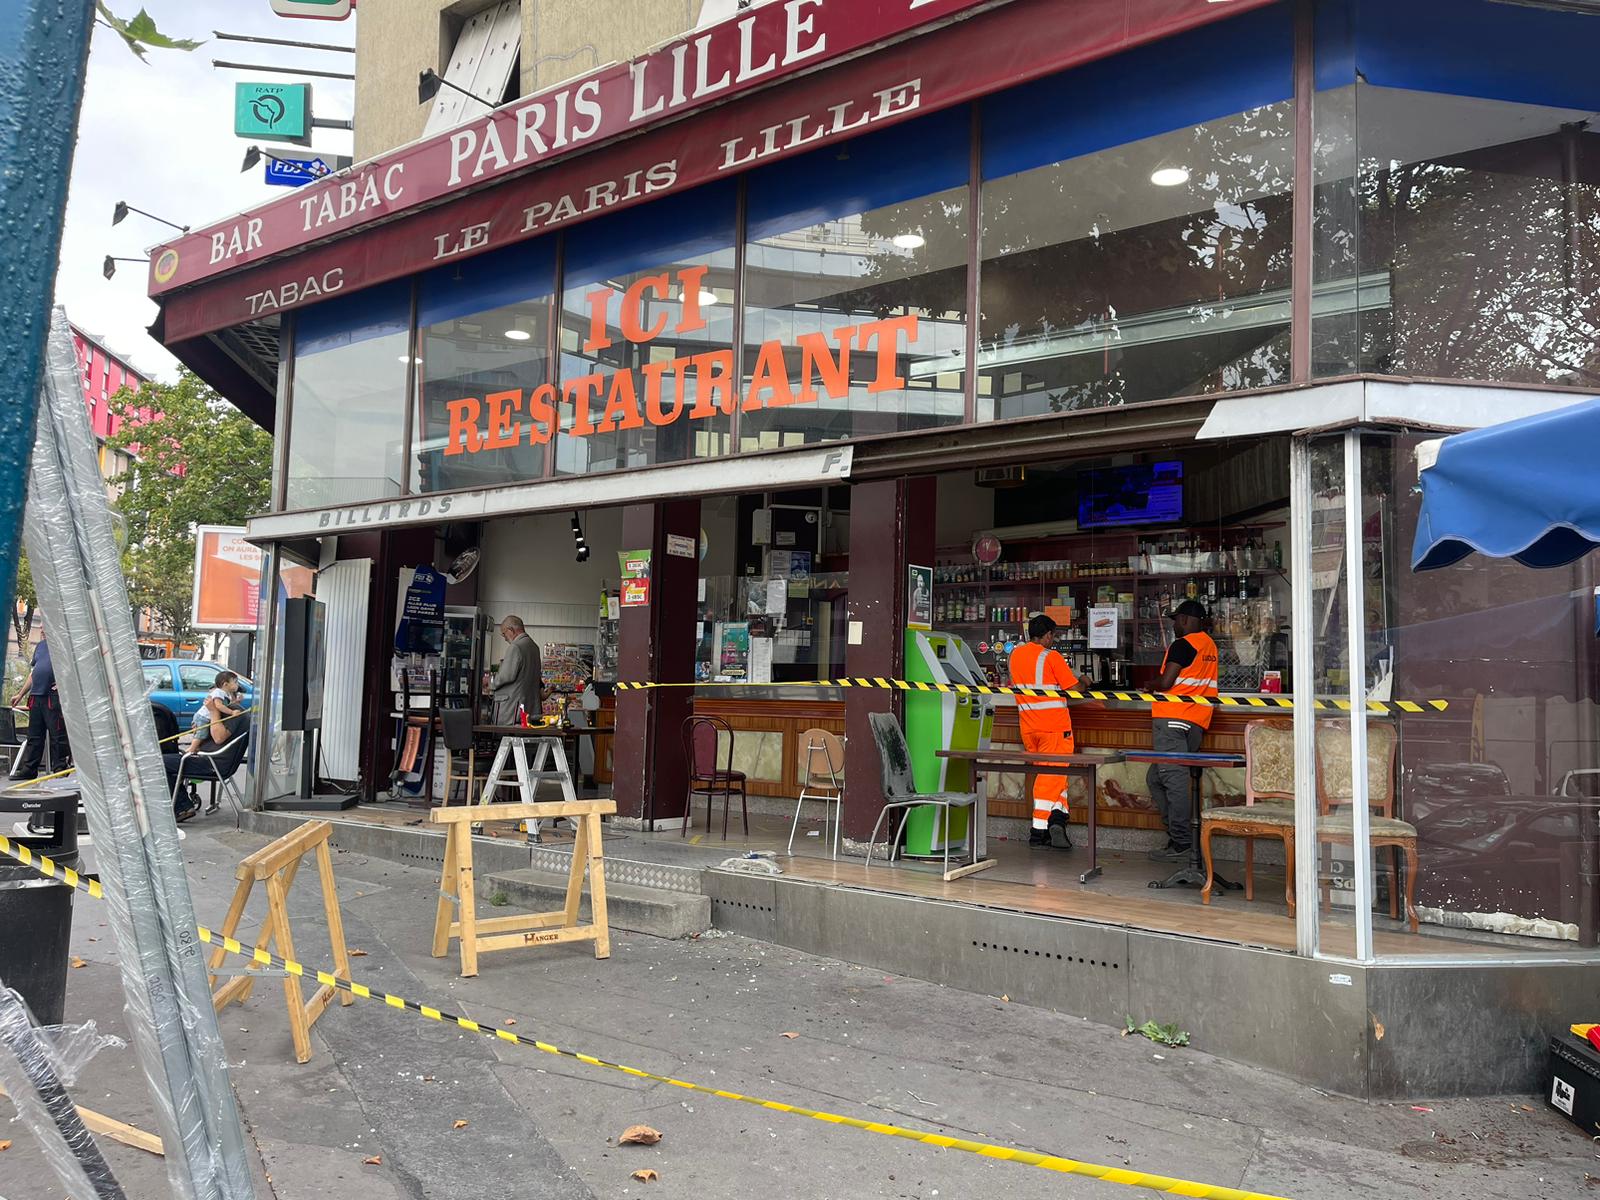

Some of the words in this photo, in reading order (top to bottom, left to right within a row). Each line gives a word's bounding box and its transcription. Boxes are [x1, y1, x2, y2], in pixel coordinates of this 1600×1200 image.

[255, 86, 284, 94] RATP
[209, 218, 263, 265] BAR
[300, 162, 404, 232] TABAC
[448, 79, 602, 187] PARIS
[628, 0, 827, 123] LILLE
[274, 160, 304, 174] FDJ
[433, 221, 491, 261] LE
[520, 159, 678, 233] PARIS
[718, 78, 922, 171] LILLE
[245, 267, 344, 315] TABAC
[583, 265, 709, 353] ICI
[443, 314, 919, 457] RESTAURANT
[318, 496, 455, 529] BILLARDS
[524, 932, 559, 945] HANGER
[148, 976, 167, 1004] 2180
